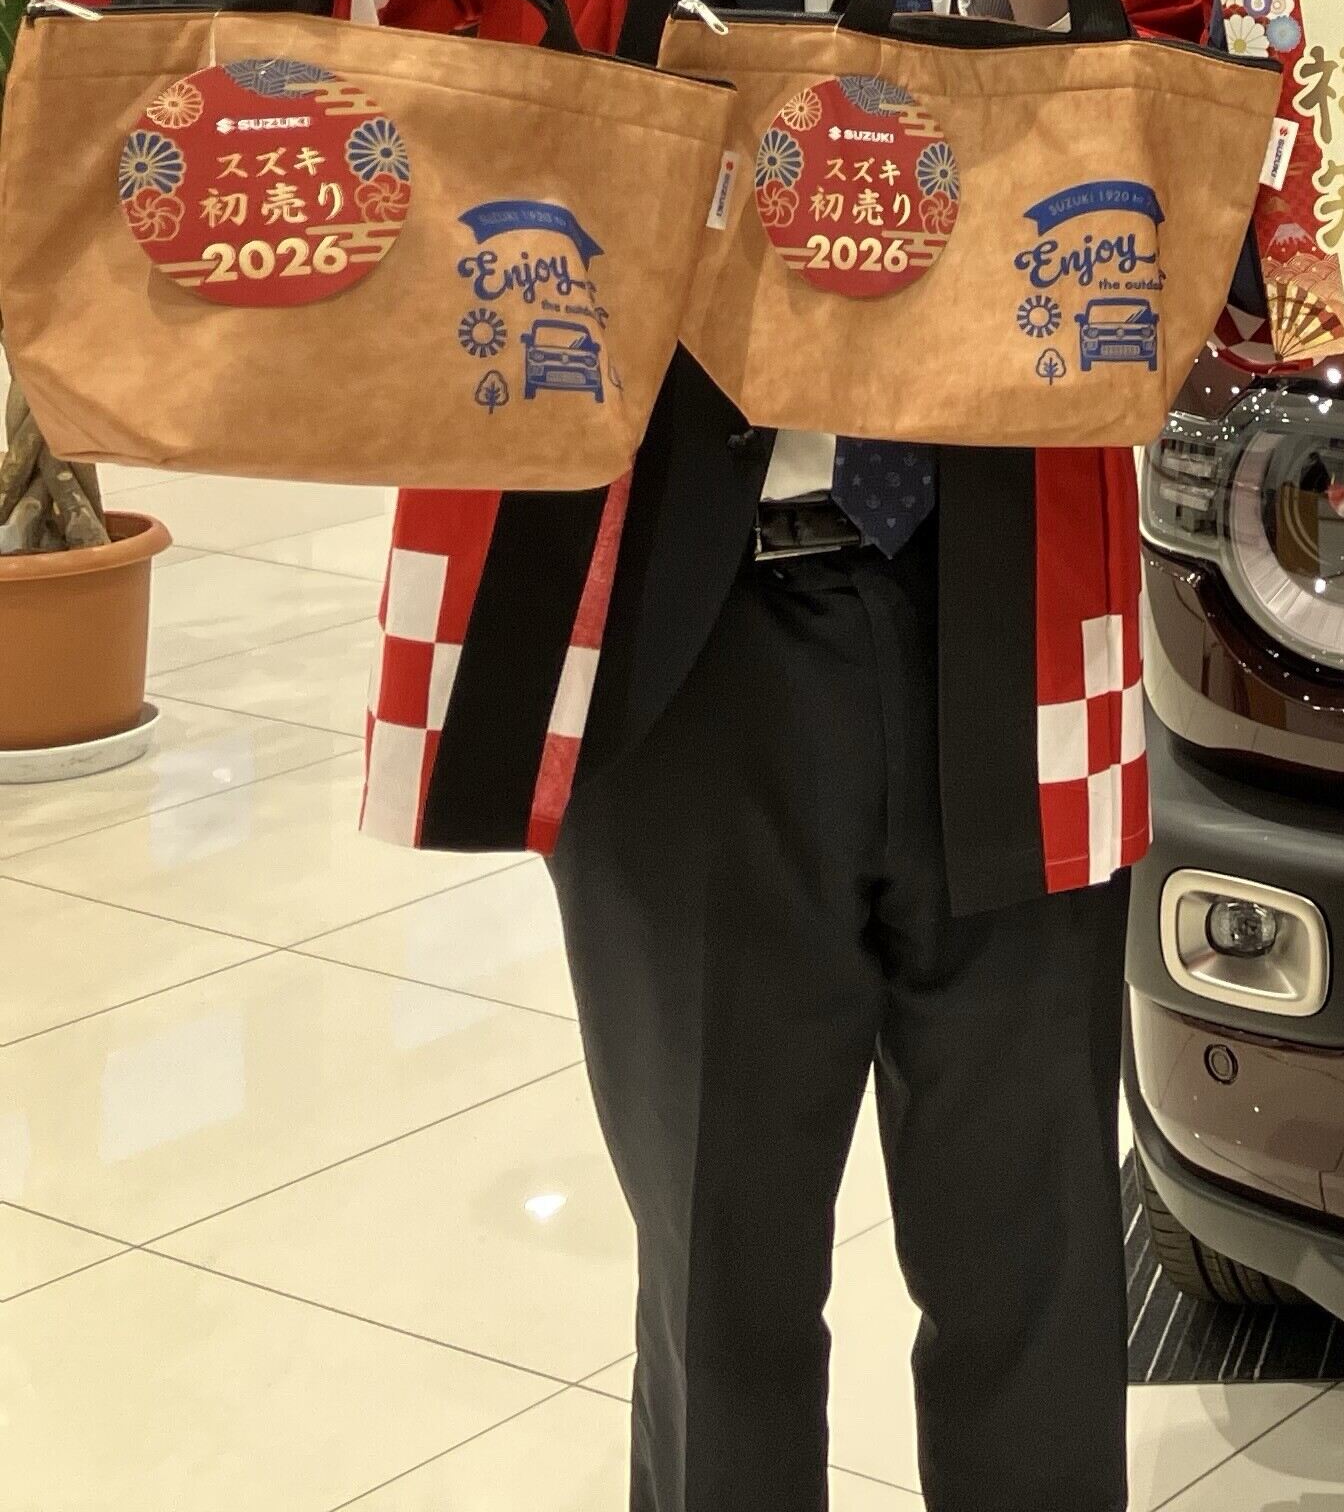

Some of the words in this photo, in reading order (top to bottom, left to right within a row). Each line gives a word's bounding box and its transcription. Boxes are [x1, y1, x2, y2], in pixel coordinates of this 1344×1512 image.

[236, 115, 312, 131] SUZUKI
[844, 128, 894, 144] SUZUKI
[215, 145, 327, 181] スズキ
[824, 156, 902, 187] スズキ
[198, 181, 344, 229] 初売り
[807, 186, 912, 229] 初売り
[201, 234, 349, 284] 2026
[805, 233, 909, 273] 2026
[1013, 232, 1157, 289] Enjoy
[456, 249, 598, 304] Enjoy
[1098, 277, 1121, 290] the
